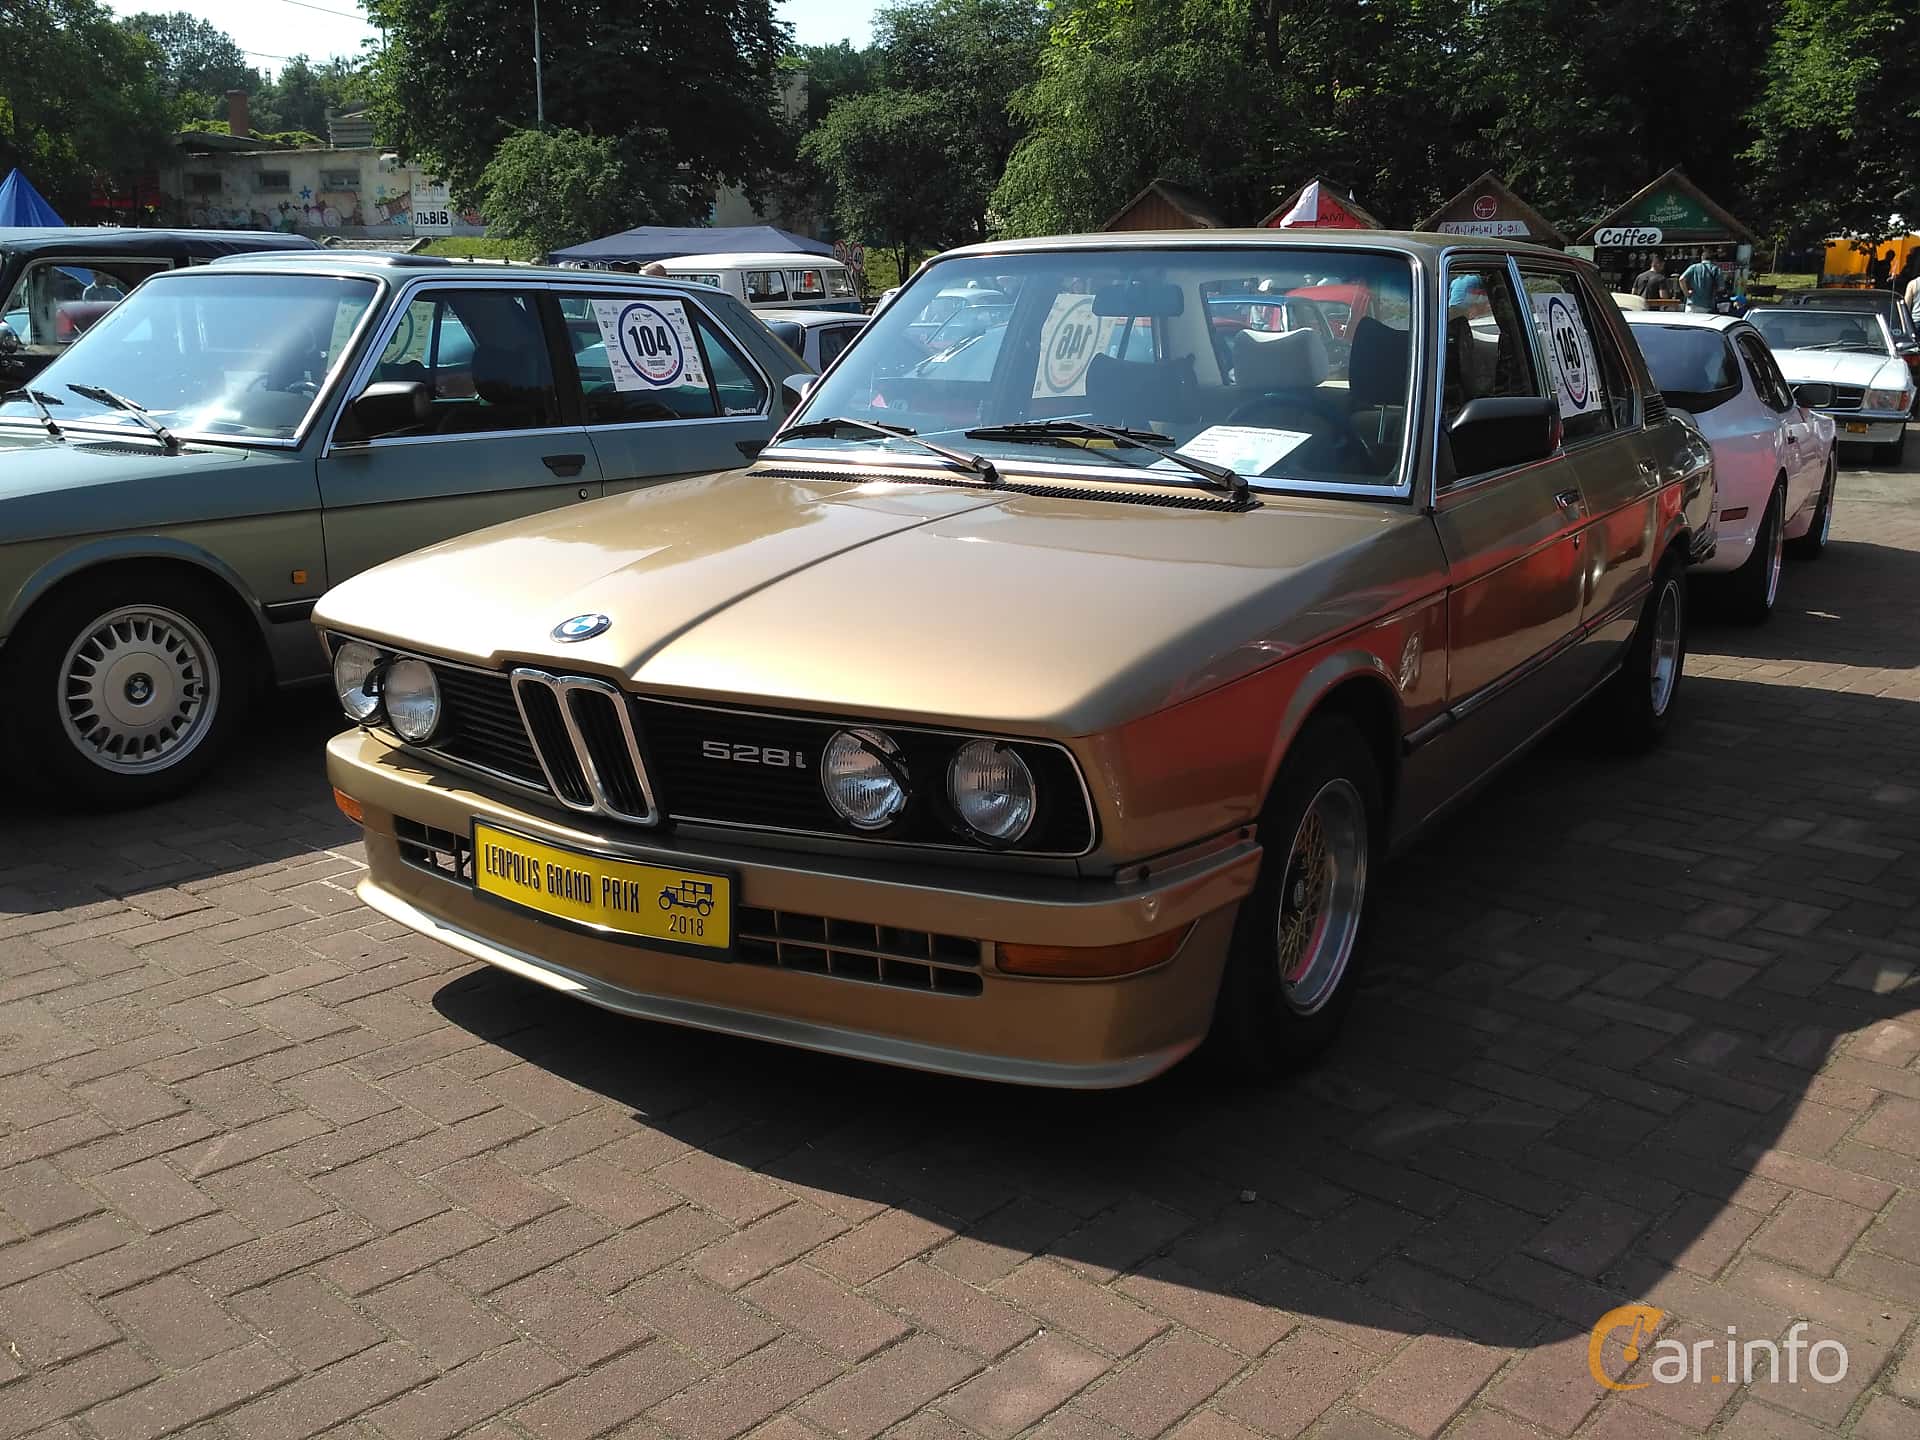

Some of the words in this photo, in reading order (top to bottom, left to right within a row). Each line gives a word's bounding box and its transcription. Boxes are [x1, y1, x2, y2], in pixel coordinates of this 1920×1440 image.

[415, 211, 449, 225] ЛЬВІВ
[1600, 228, 1658, 245] Coffee
[628, 325, 672, 356] 104
[1556, 327, 1581, 370] 146
[703, 740, 807, 769] 528i
[484, 843, 541, 890] LEOPOLIS
[546, 863, 592, 904] GRAND
[601, 875, 640, 913] PRIX
[669, 913, 705, 938] 2018
